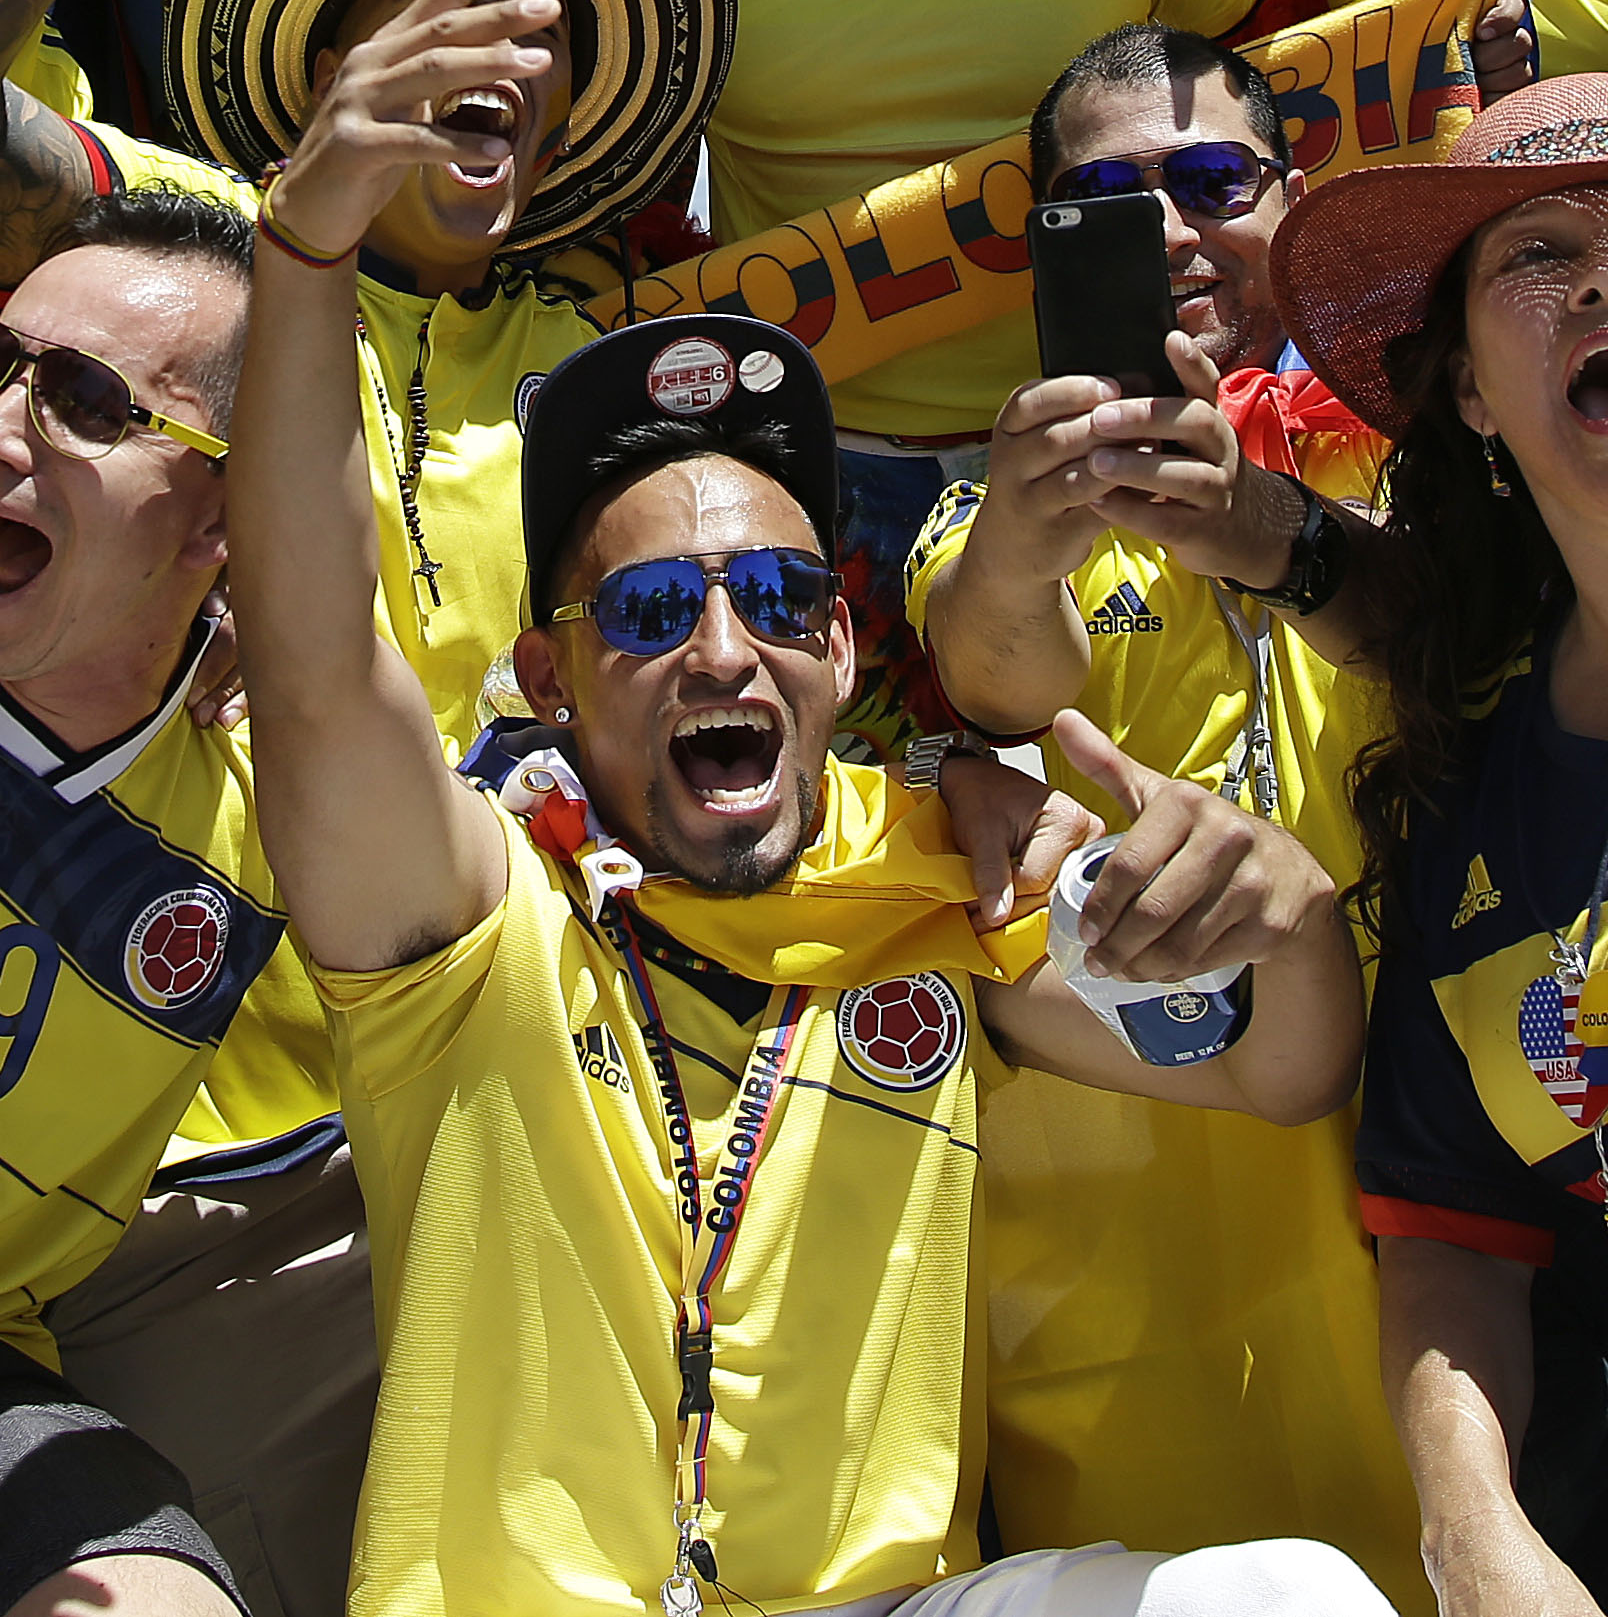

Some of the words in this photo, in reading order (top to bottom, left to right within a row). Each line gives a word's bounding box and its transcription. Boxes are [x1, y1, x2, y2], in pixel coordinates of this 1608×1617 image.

[1085, 614, 1164, 635] adidas
[918, 973, 931, 985] DE
[930, 981, 955, 1012] FUTBOL
[1544, 1059, 1576, 1081] USA
[704, 1044, 787, 1236] COLOMBIA
